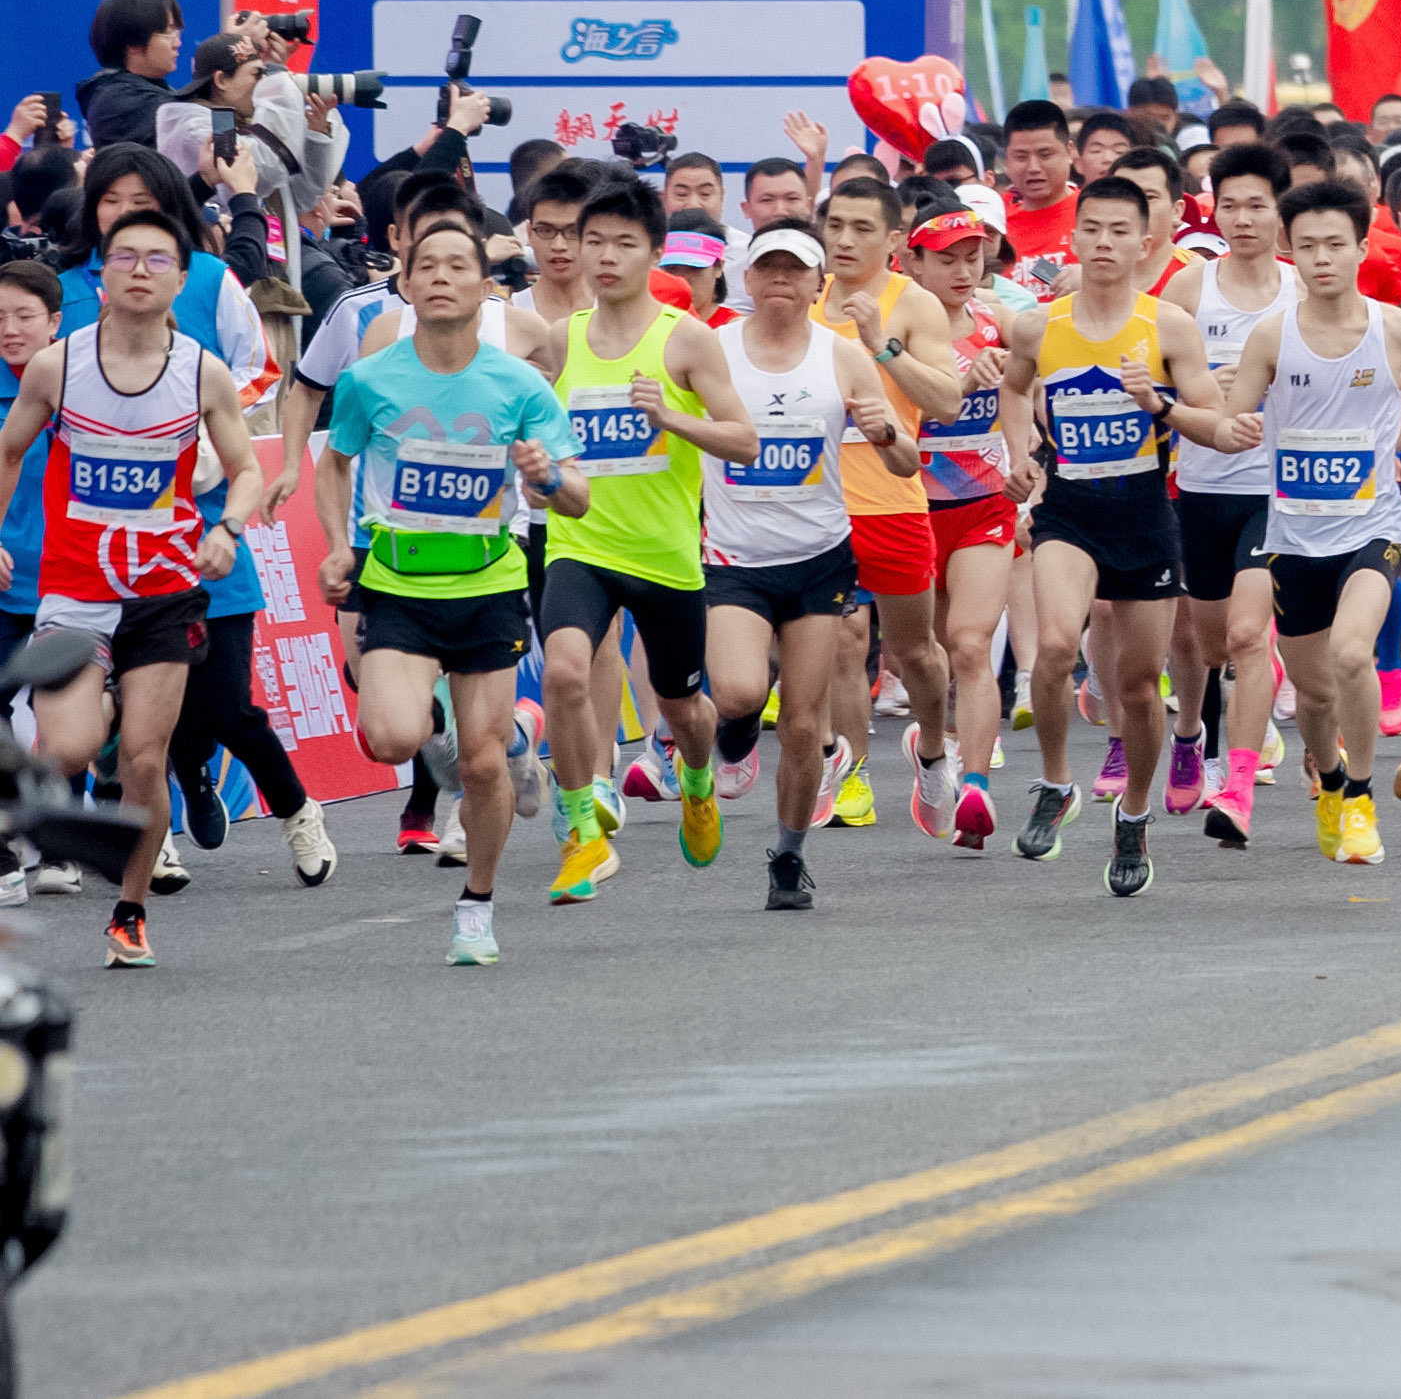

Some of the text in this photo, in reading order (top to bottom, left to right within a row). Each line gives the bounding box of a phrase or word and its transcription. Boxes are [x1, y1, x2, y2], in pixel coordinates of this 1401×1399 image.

[875, 72, 953, 101] 1:10
[570, 412, 652, 443] B1453
[1059, 417, 1142, 449] B1455
[74, 460, 162, 495] B1534
[399, 466, 491, 502] B1590
[1280, 455, 1362, 484] B1652
